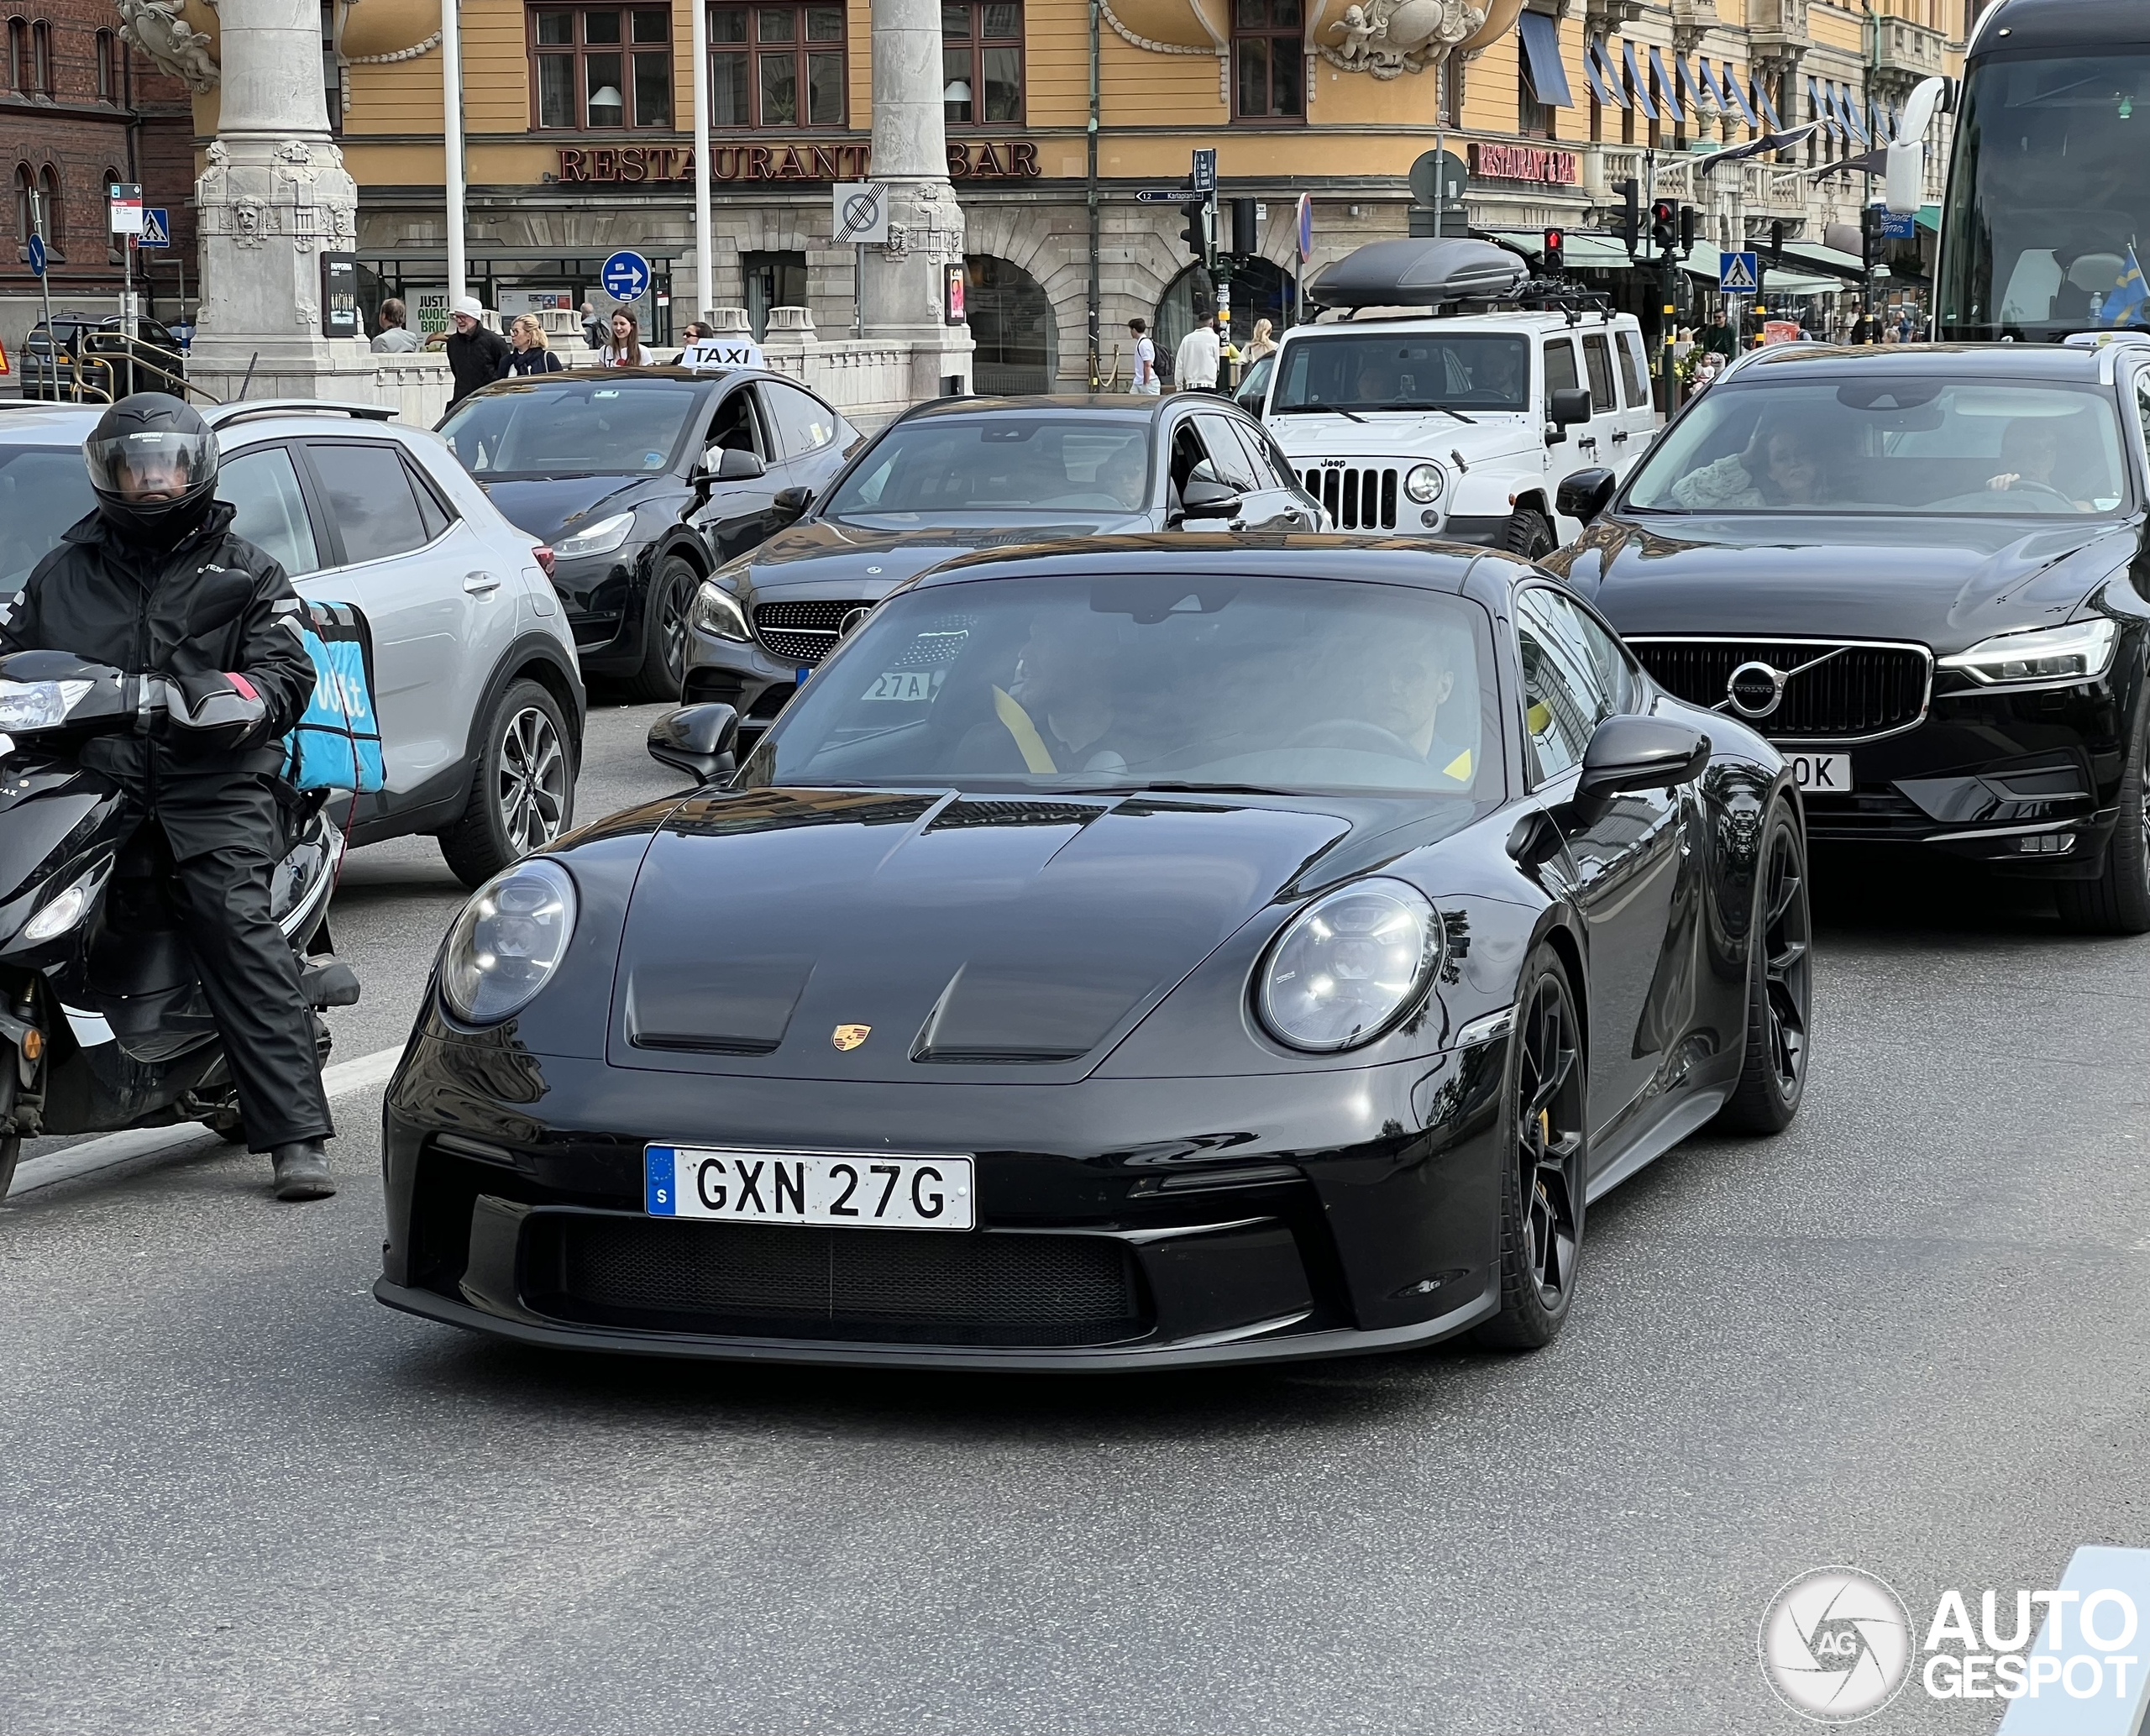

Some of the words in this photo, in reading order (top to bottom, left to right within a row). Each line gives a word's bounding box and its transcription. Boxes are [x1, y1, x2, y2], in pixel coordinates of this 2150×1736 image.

[556, 144, 871, 182] RESTAURANT
[946, 141, 1041, 177] BAR
[1478, 144, 1546, 181] RESTAURANT
[1548, 150, 1556, 182] &
[1556, 152, 1576, 184] BAR
[419, 295, 444, 307] JUST
[421, 321, 448, 333] BRIO
[692, 347, 750, 365] TAXI
[1320, 458, 1346, 469] Jeep
[875, 675, 920, 697] 27A
[657, 1188, 667, 1204] S
[696, 1157, 805, 1215] GXN
[829, 1163, 944, 1219] 27G
